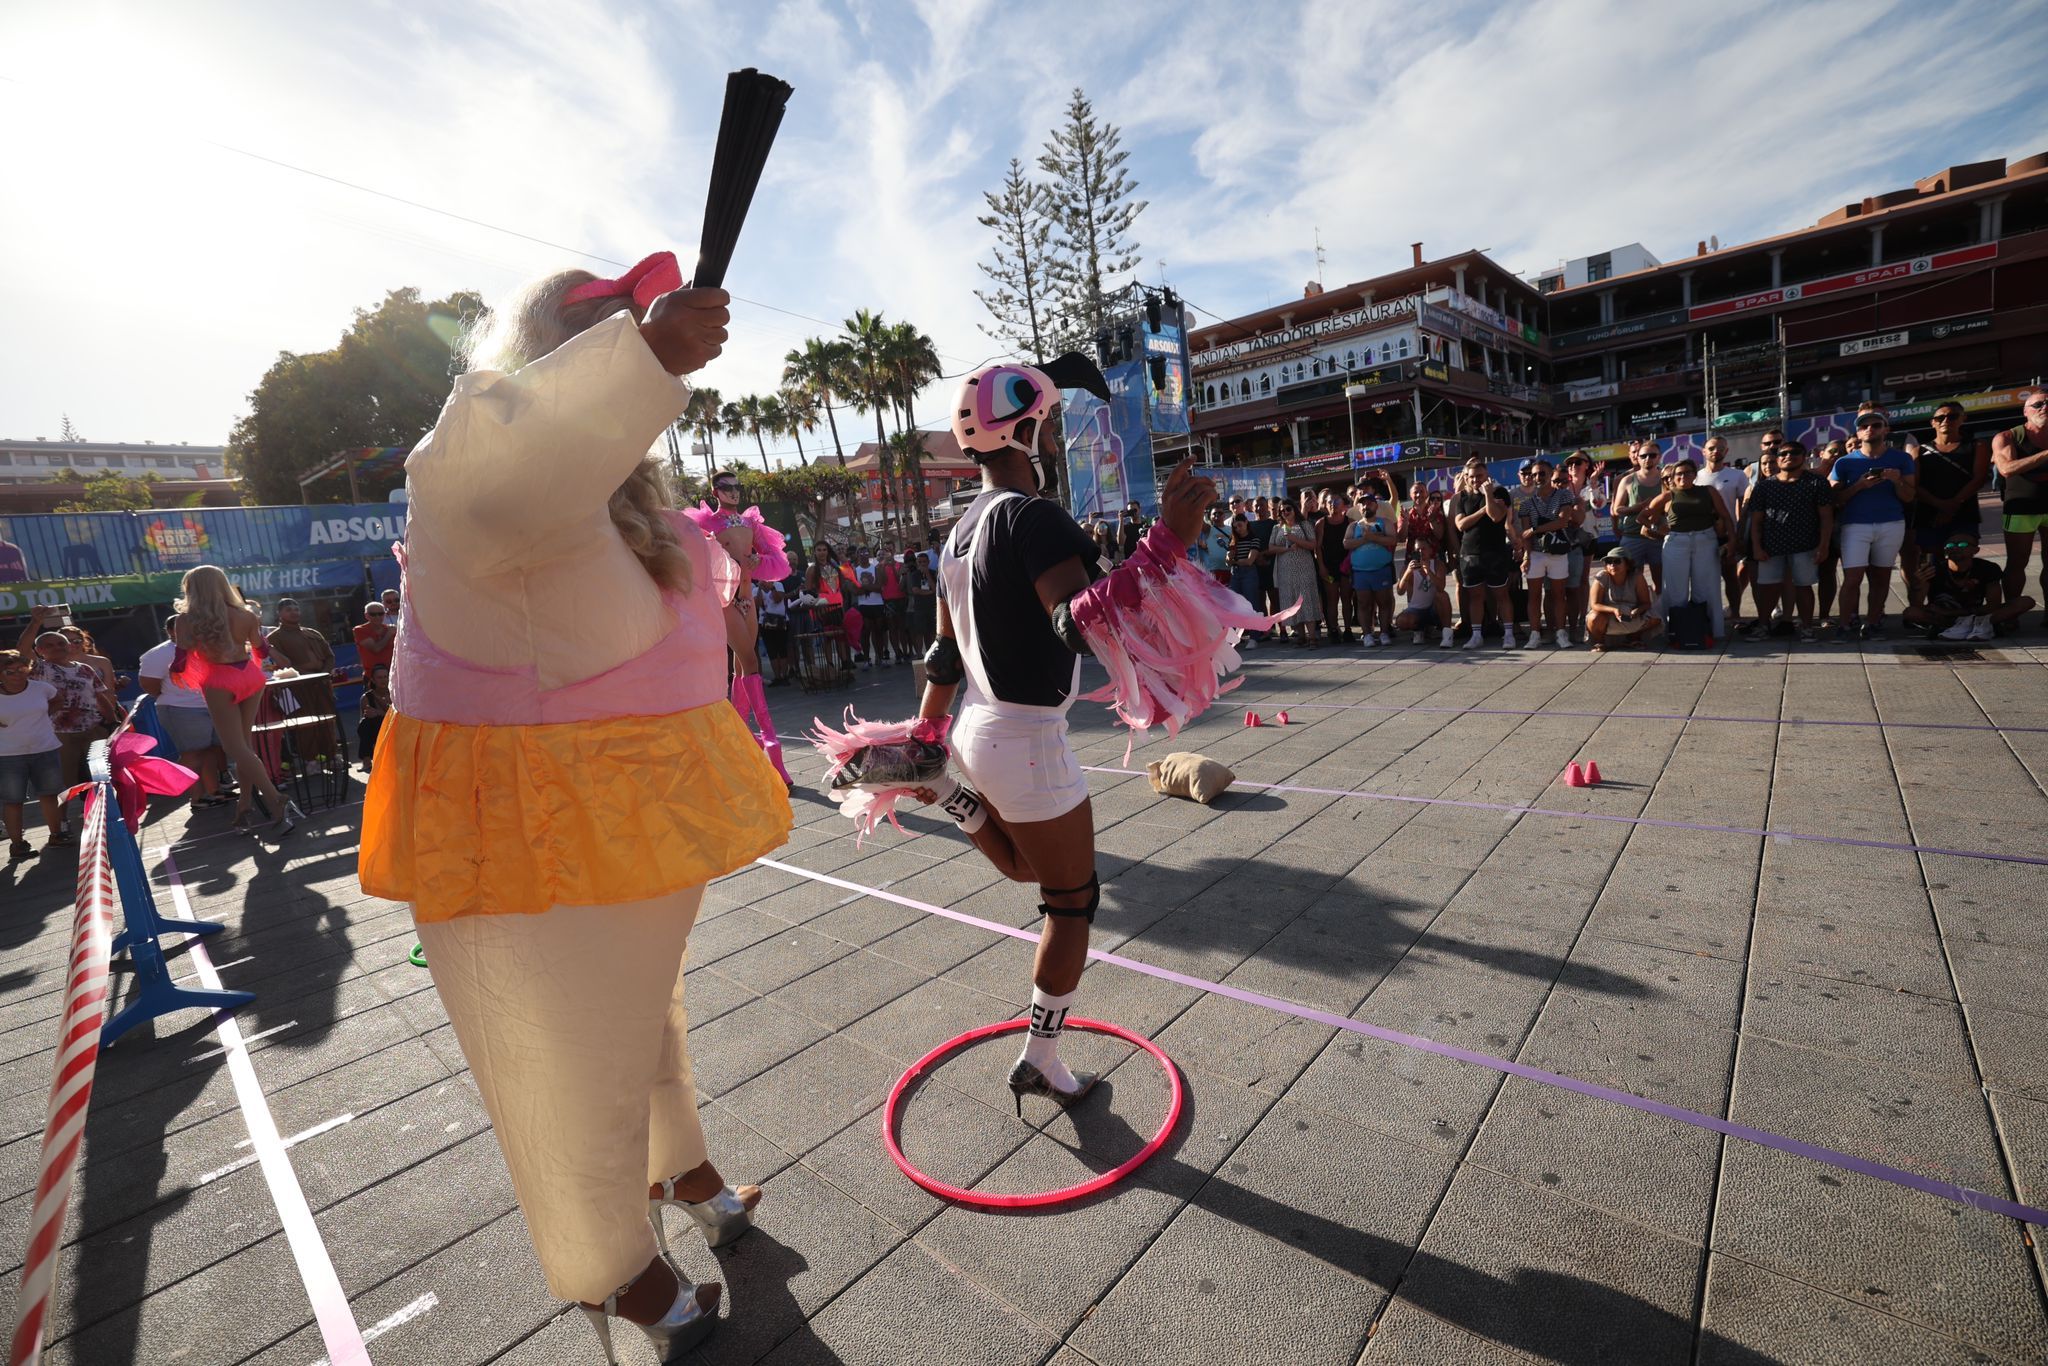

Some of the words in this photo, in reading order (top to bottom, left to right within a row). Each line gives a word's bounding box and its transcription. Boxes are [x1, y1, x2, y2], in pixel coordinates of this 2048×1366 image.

[1854, 264, 1906, 284] SPAR
[1735, 292, 1780, 309] SPAR
[1967, 320, 1989, 329] PARIS
[1198, 344, 1241, 369] INDIAN
[1247, 324, 1317, 353] TANDOORI
[1883, 368, 1968, 386] COOL
[1900, 405, 1932, 416] PASAR
[154, 533, 198, 546] PRIDE
[279, 567, 320, 588] HERE
[20, 587, 59, 609] TO
[64, 584, 116, 605] MIX
